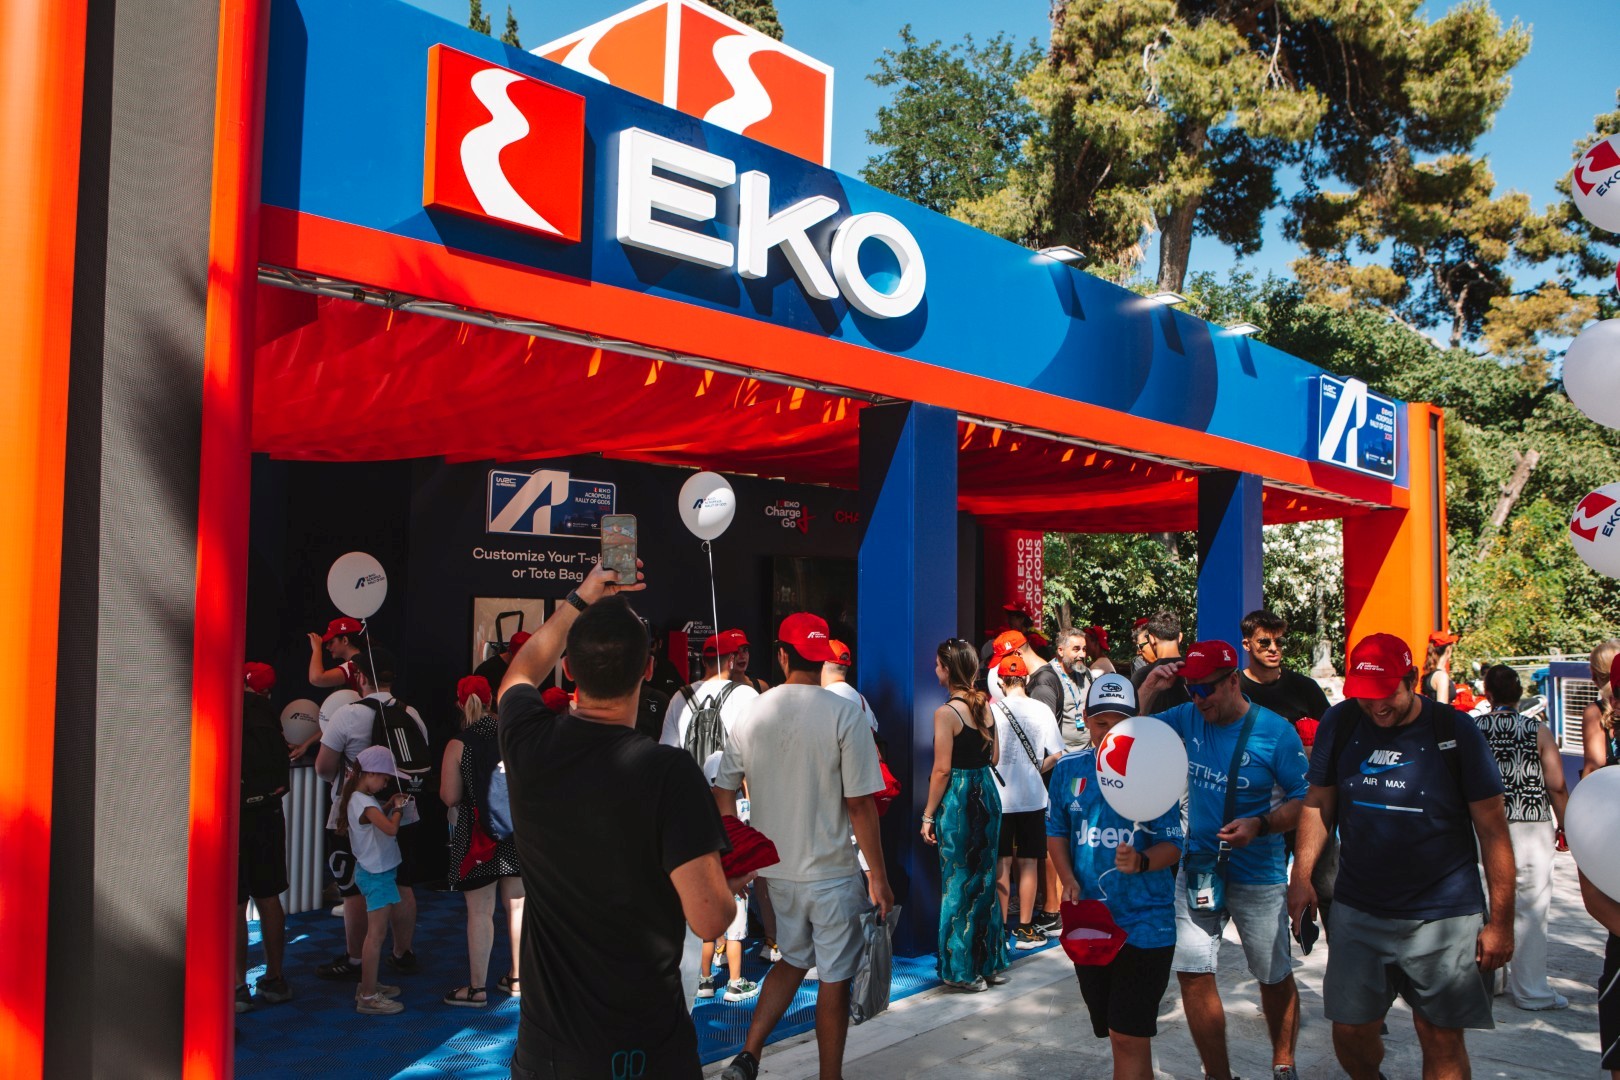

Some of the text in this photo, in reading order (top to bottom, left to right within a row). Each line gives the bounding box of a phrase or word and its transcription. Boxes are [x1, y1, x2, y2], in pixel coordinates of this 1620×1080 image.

[617, 127, 926, 319] EKO
[765, 506, 800, 519] Charge
[781, 518, 796, 528] Go
[472, 547, 545, 562] Customize
[547, 551, 576, 563] Your
[1017, 538, 1025, 576] EKO
[1034, 539, 1042, 581] GODS
[512, 567, 584, 582] or Tote Bag
[1034, 584, 1042, 605] OF
[1368, 750, 1402, 765] NIKE
[1100, 776, 1124, 789] EKO
[1363, 777, 1406, 789] AIR MAX
[1075, 819, 1134, 848] Jeep
